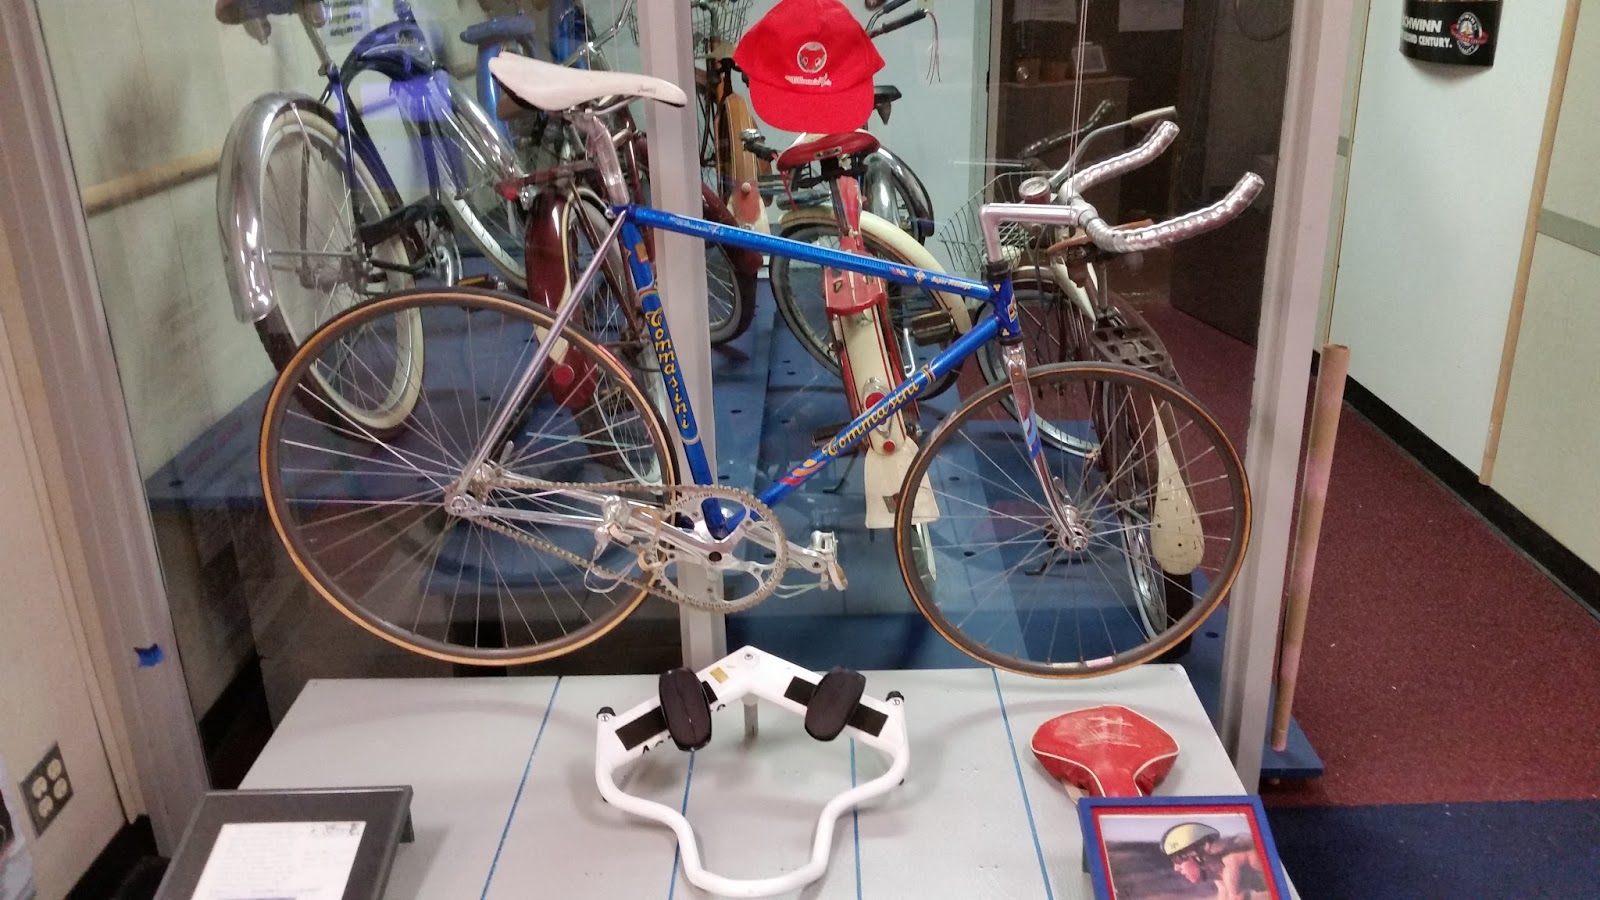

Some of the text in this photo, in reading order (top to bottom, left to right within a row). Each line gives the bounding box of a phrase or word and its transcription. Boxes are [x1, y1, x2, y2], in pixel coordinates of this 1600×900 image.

[1418, 35, 1453, 48] CENTURY.
[645, 308, 690, 429] Tommasini
[821, 378, 920, 457] Tommasini
